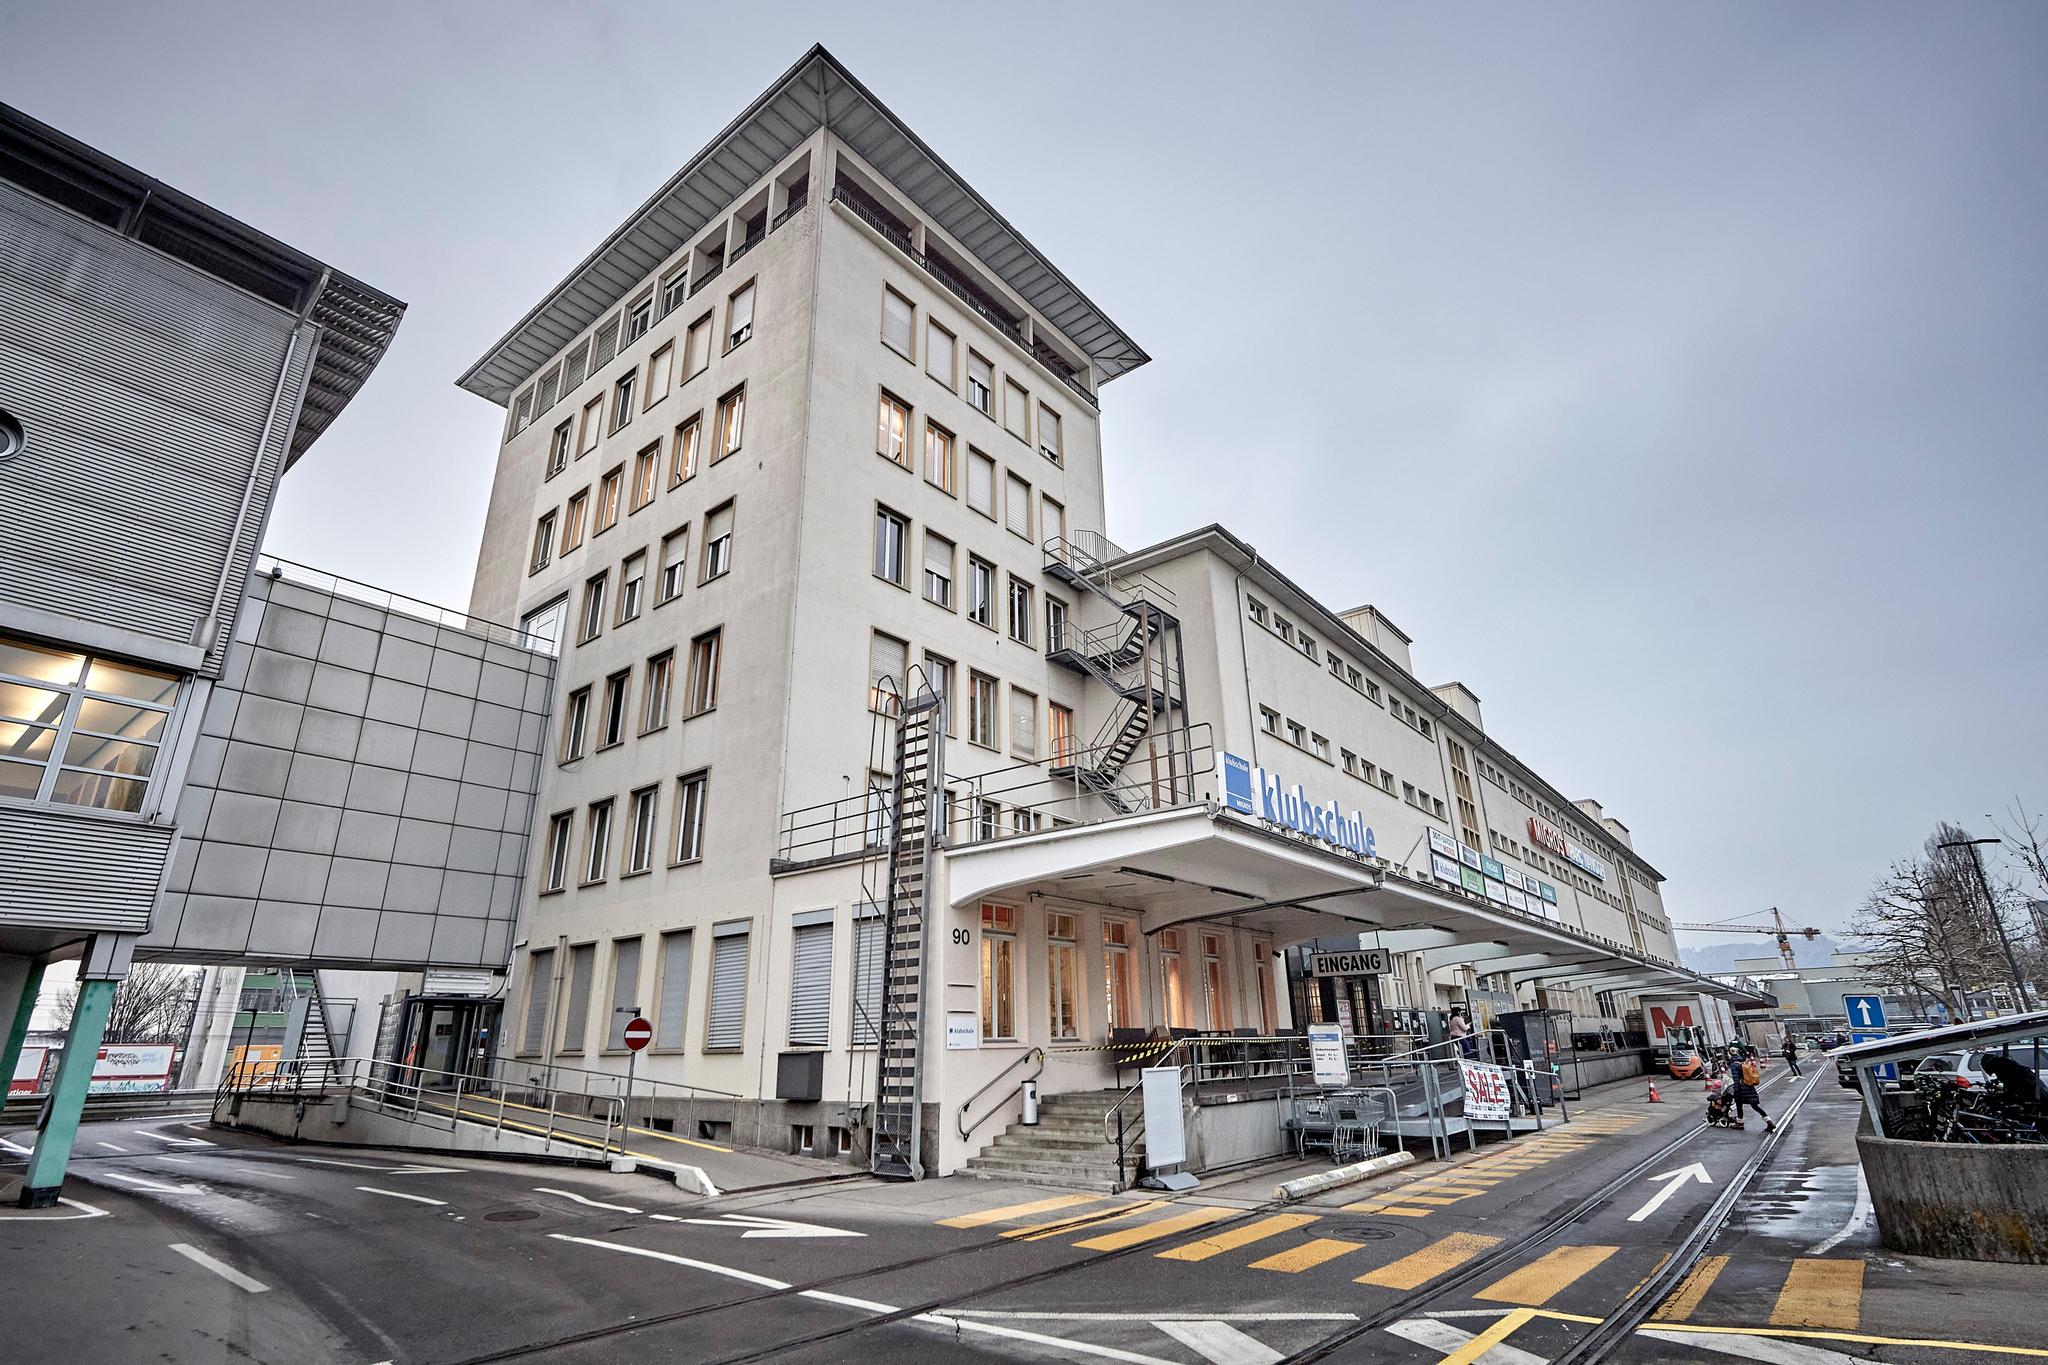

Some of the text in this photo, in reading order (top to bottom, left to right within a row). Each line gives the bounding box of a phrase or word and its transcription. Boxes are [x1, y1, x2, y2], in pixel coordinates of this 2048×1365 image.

[1255, 767, 1377, 858] klubschule
[953, 928, 970, 945] 90
[1317, 953, 1381, 973] EINGANG
[1650, 1006, 1693, 1039] M
[1468, 1069, 1505, 1104] SALE
